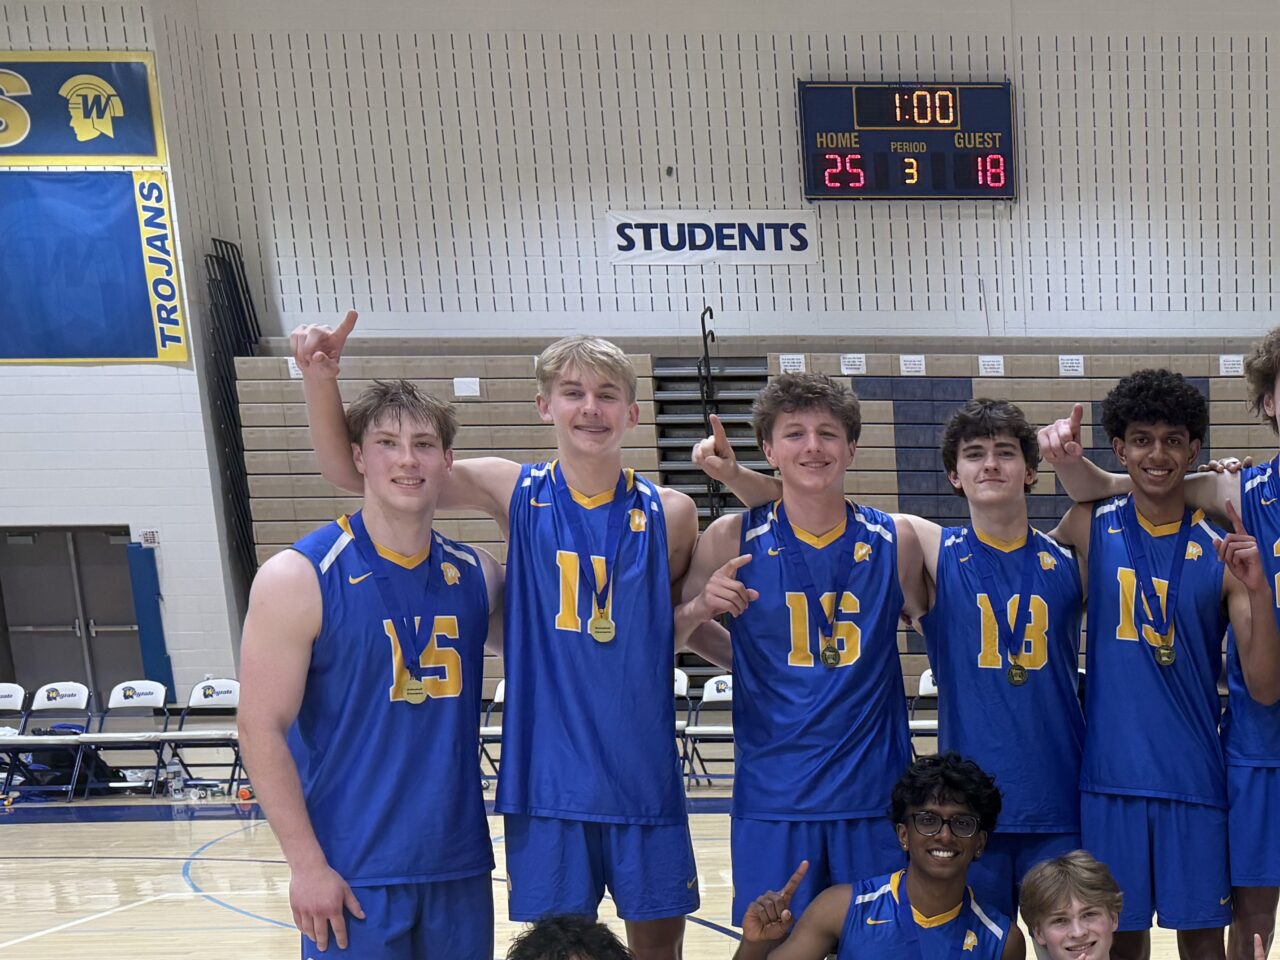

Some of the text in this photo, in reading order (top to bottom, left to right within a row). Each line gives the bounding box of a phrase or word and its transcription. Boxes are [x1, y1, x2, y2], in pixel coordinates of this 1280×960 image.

[895, 90, 954, 124] 1:00
[816, 132, 860, 148] HOME
[890, 142, 927, 153] PERIOD
[954, 132, 1002, 148] GUEST
[824, 154, 865, 187] 25
[904, 158, 918, 184] 3
[977, 154, 1005, 187] 18
[616, 222, 809, 252] STUDENTS
[138, 180, 182, 350] TROJANS
[555, 549, 616, 634] 11
[785, 591, 862, 667] 16
[383, 615, 463, 702] 15
